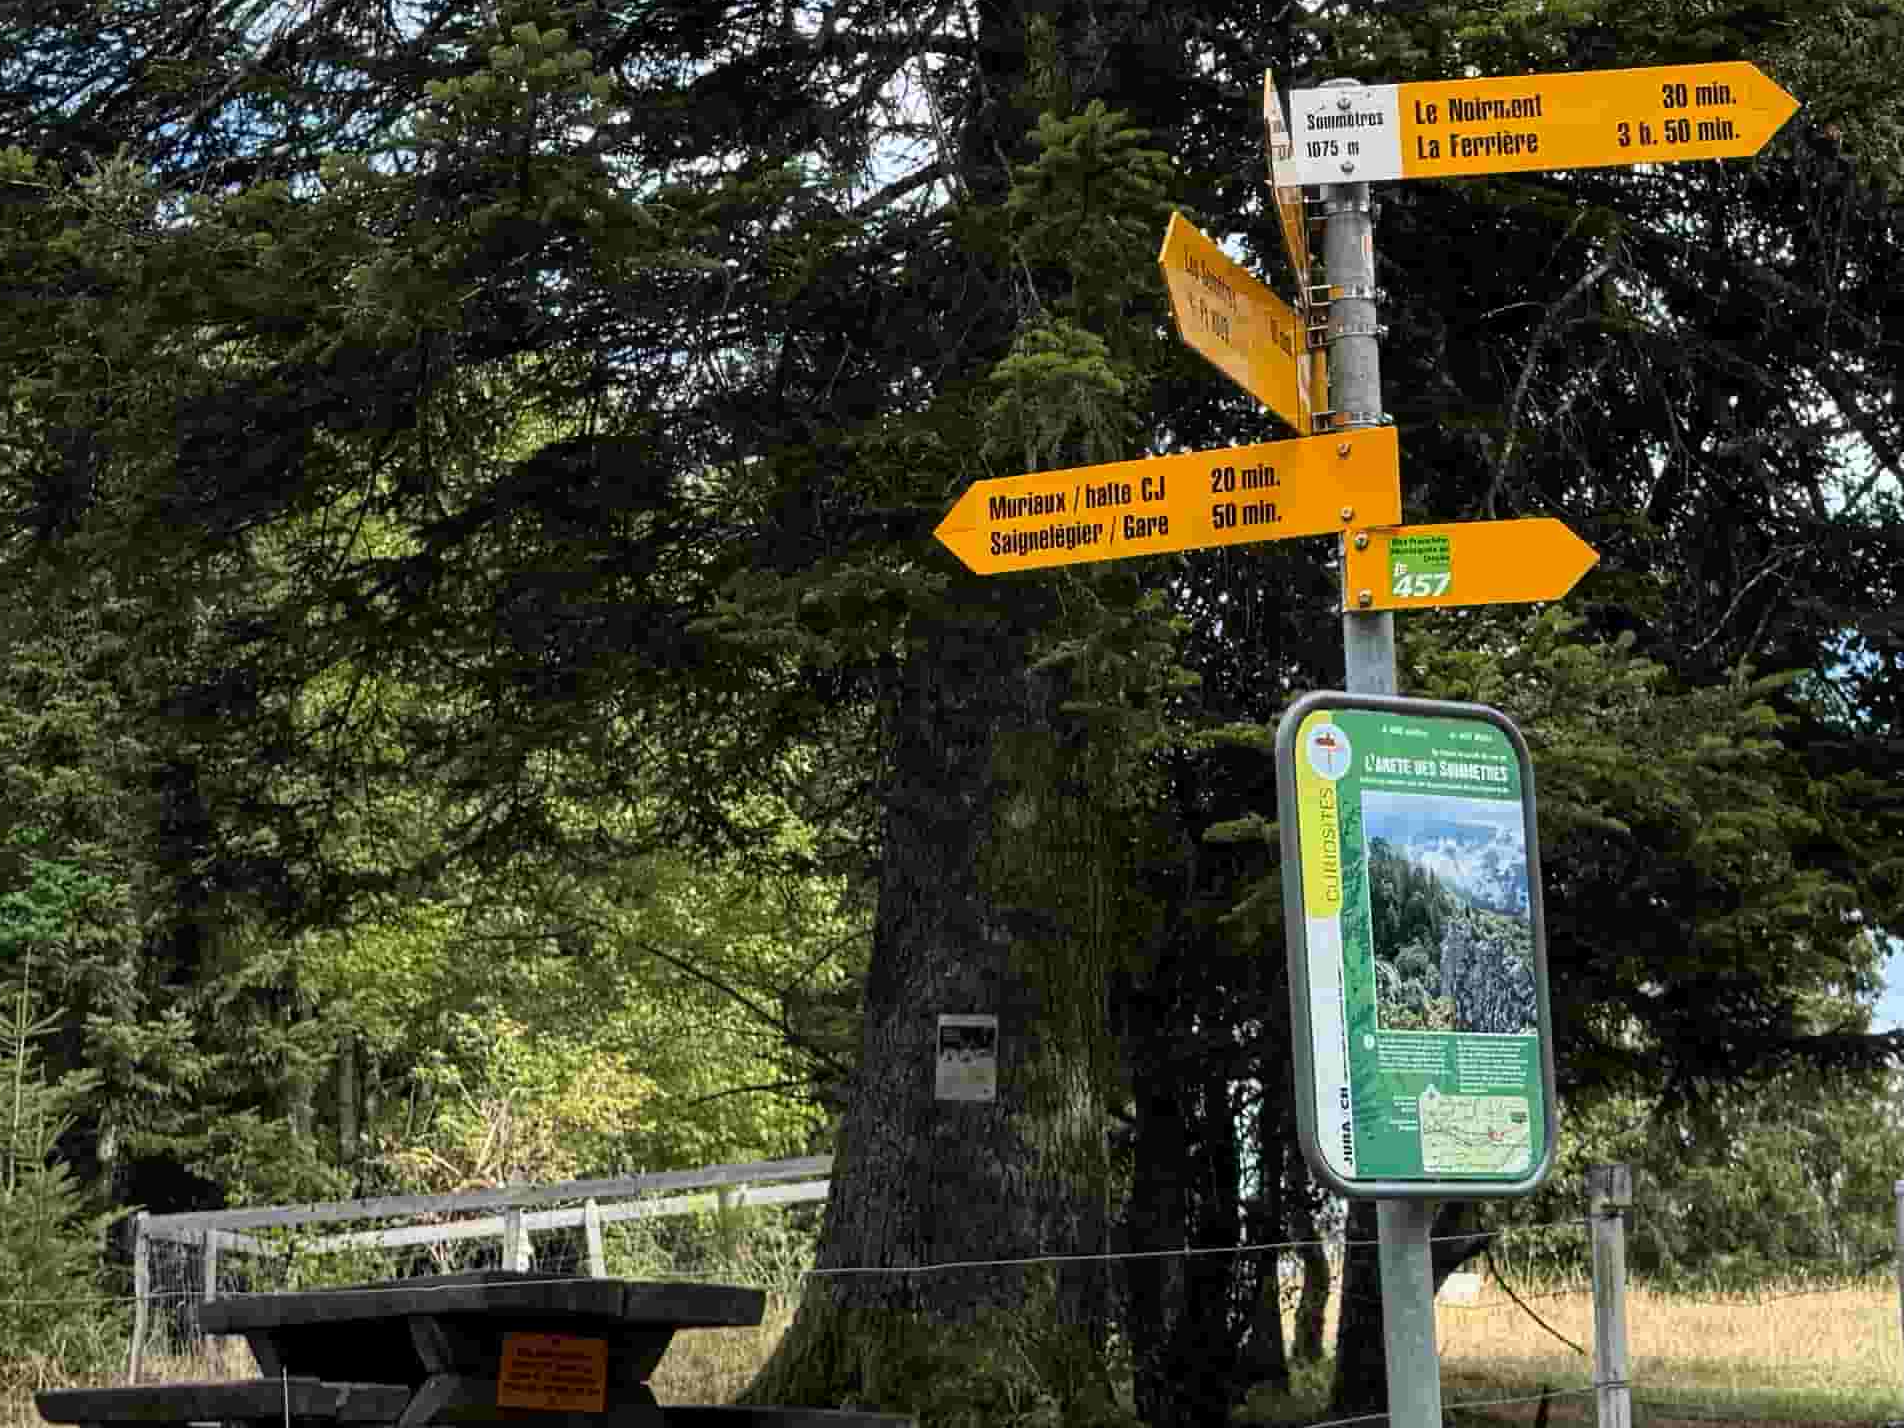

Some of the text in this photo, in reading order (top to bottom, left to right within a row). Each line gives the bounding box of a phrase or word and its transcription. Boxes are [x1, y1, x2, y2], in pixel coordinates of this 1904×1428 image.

[1414, 80, 1737, 125] Le Noirmont 30 min.
[1306, 139, 1360, 158] 1075 m
[1416, 115, 1741, 160] La Ferrière 3 h. 50 min.
[988, 491, 1066, 521] Muriaux
[1085, 481, 1132, 509] halte
[1141, 475, 1166, 503] CJ
[1210, 466, 1235, 493] 20
[1241, 462, 1281, 491] min.
[990, 520, 1104, 557] Saignelégier
[1123, 514, 1169, 541] Gare
[1212, 502, 1237, 530] 50
[1242, 499, 1283, 525] min.
[1392, 571, 1451, 597] 457
